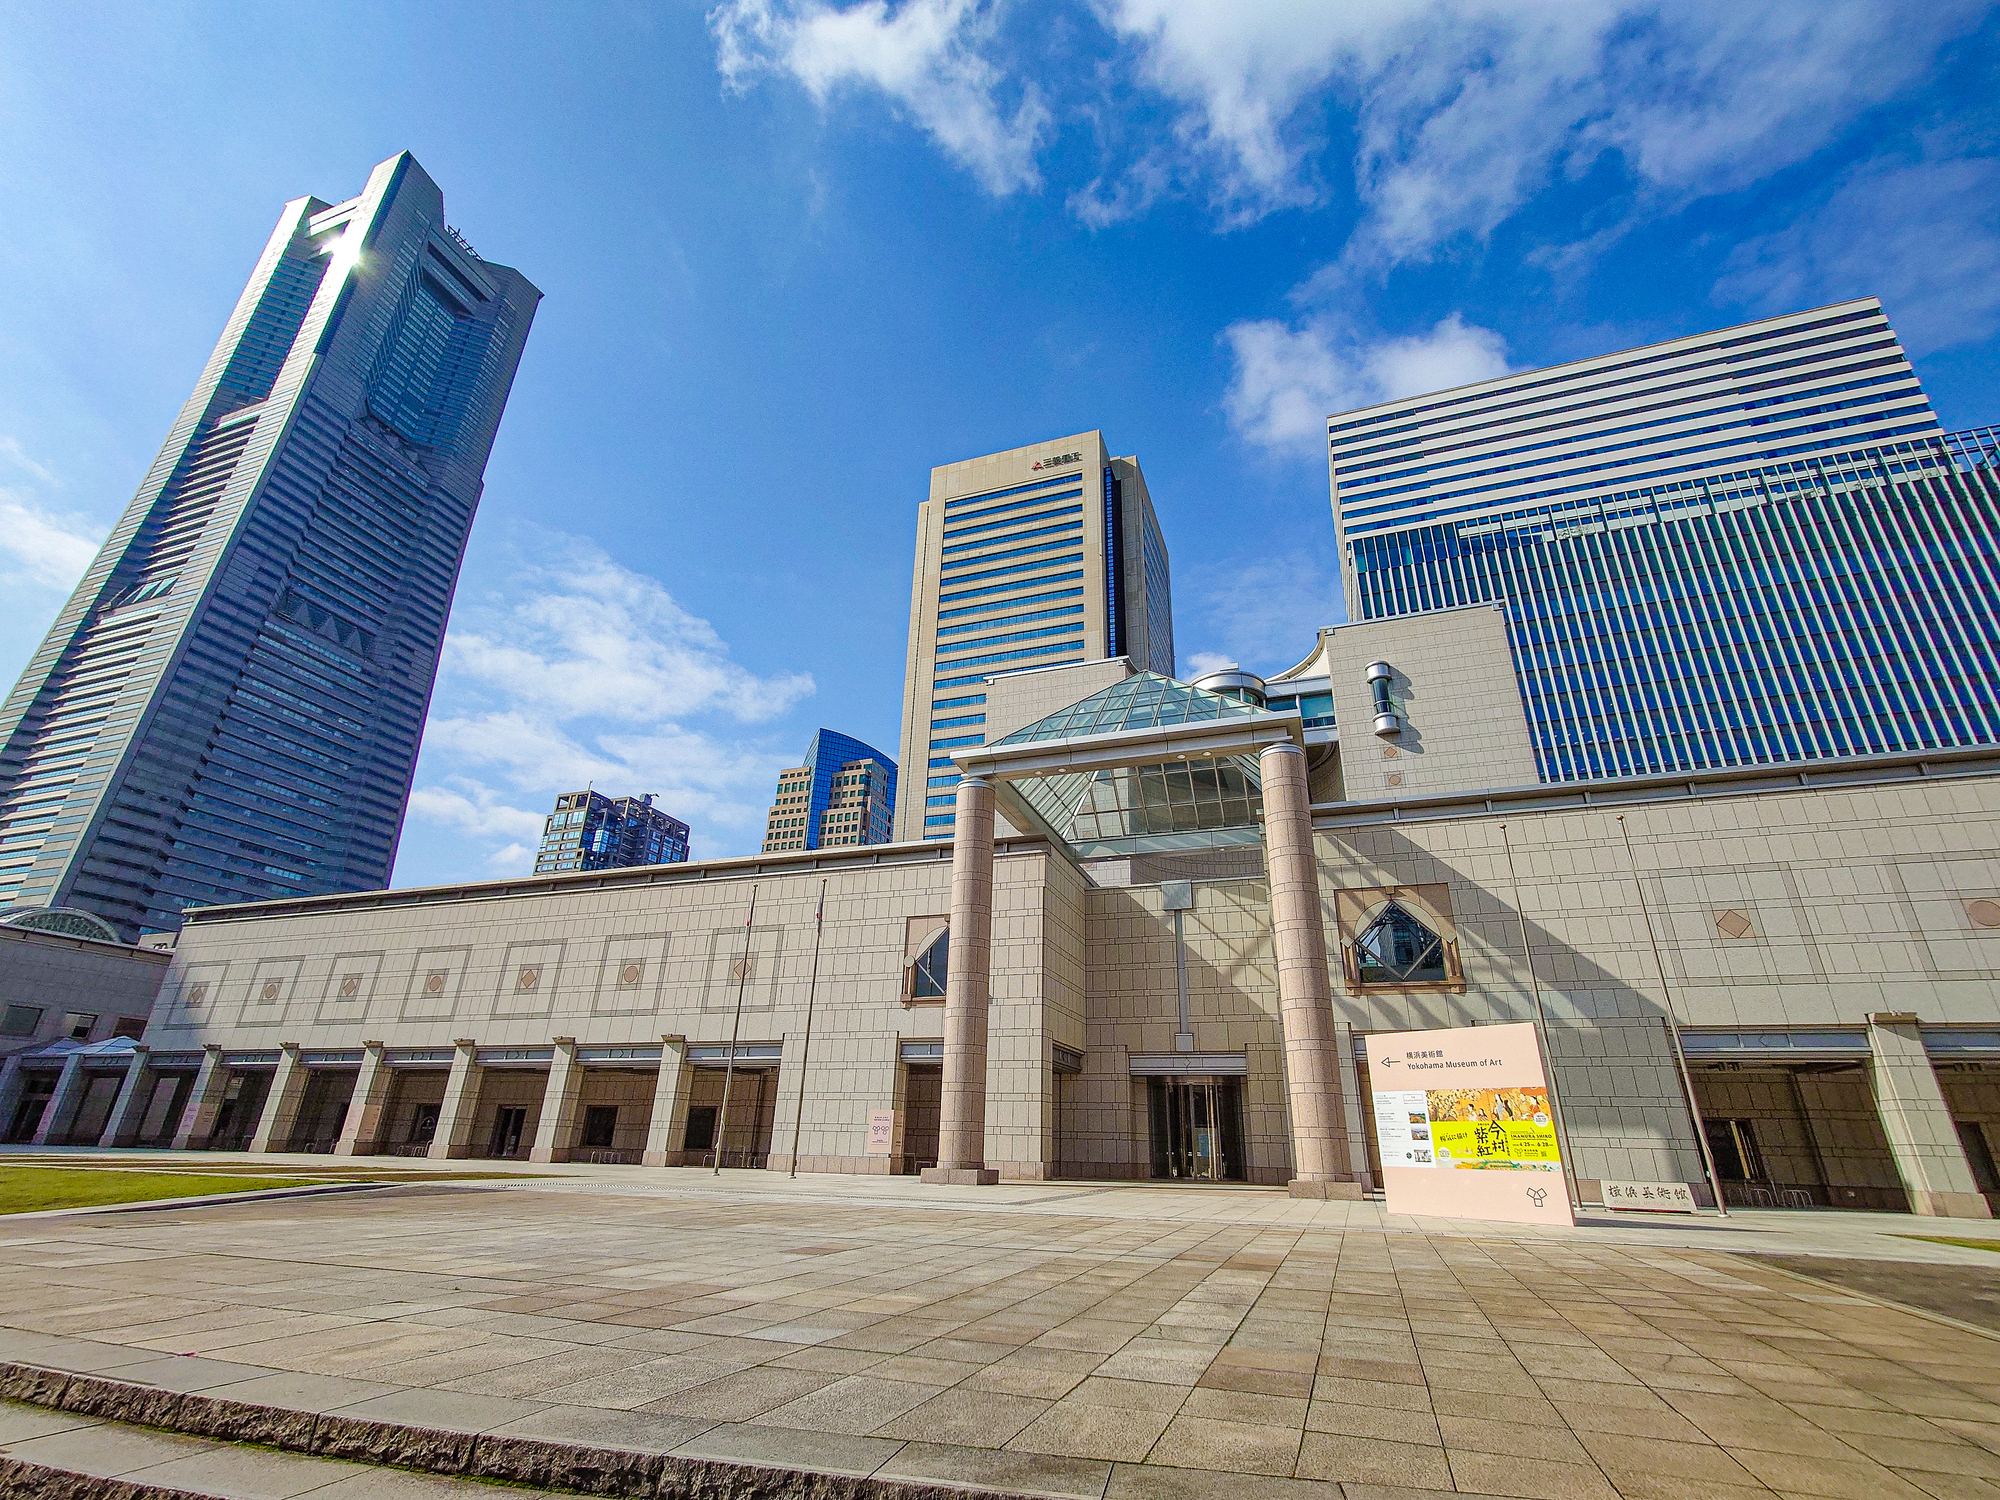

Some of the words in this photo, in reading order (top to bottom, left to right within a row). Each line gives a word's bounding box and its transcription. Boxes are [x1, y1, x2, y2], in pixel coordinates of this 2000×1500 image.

[1406, 1050, 1443, 1059] 横浜美術館
[1407, 1062, 1444, 1070] Yokohama
[1479, 1059, 1488, 1067] of
